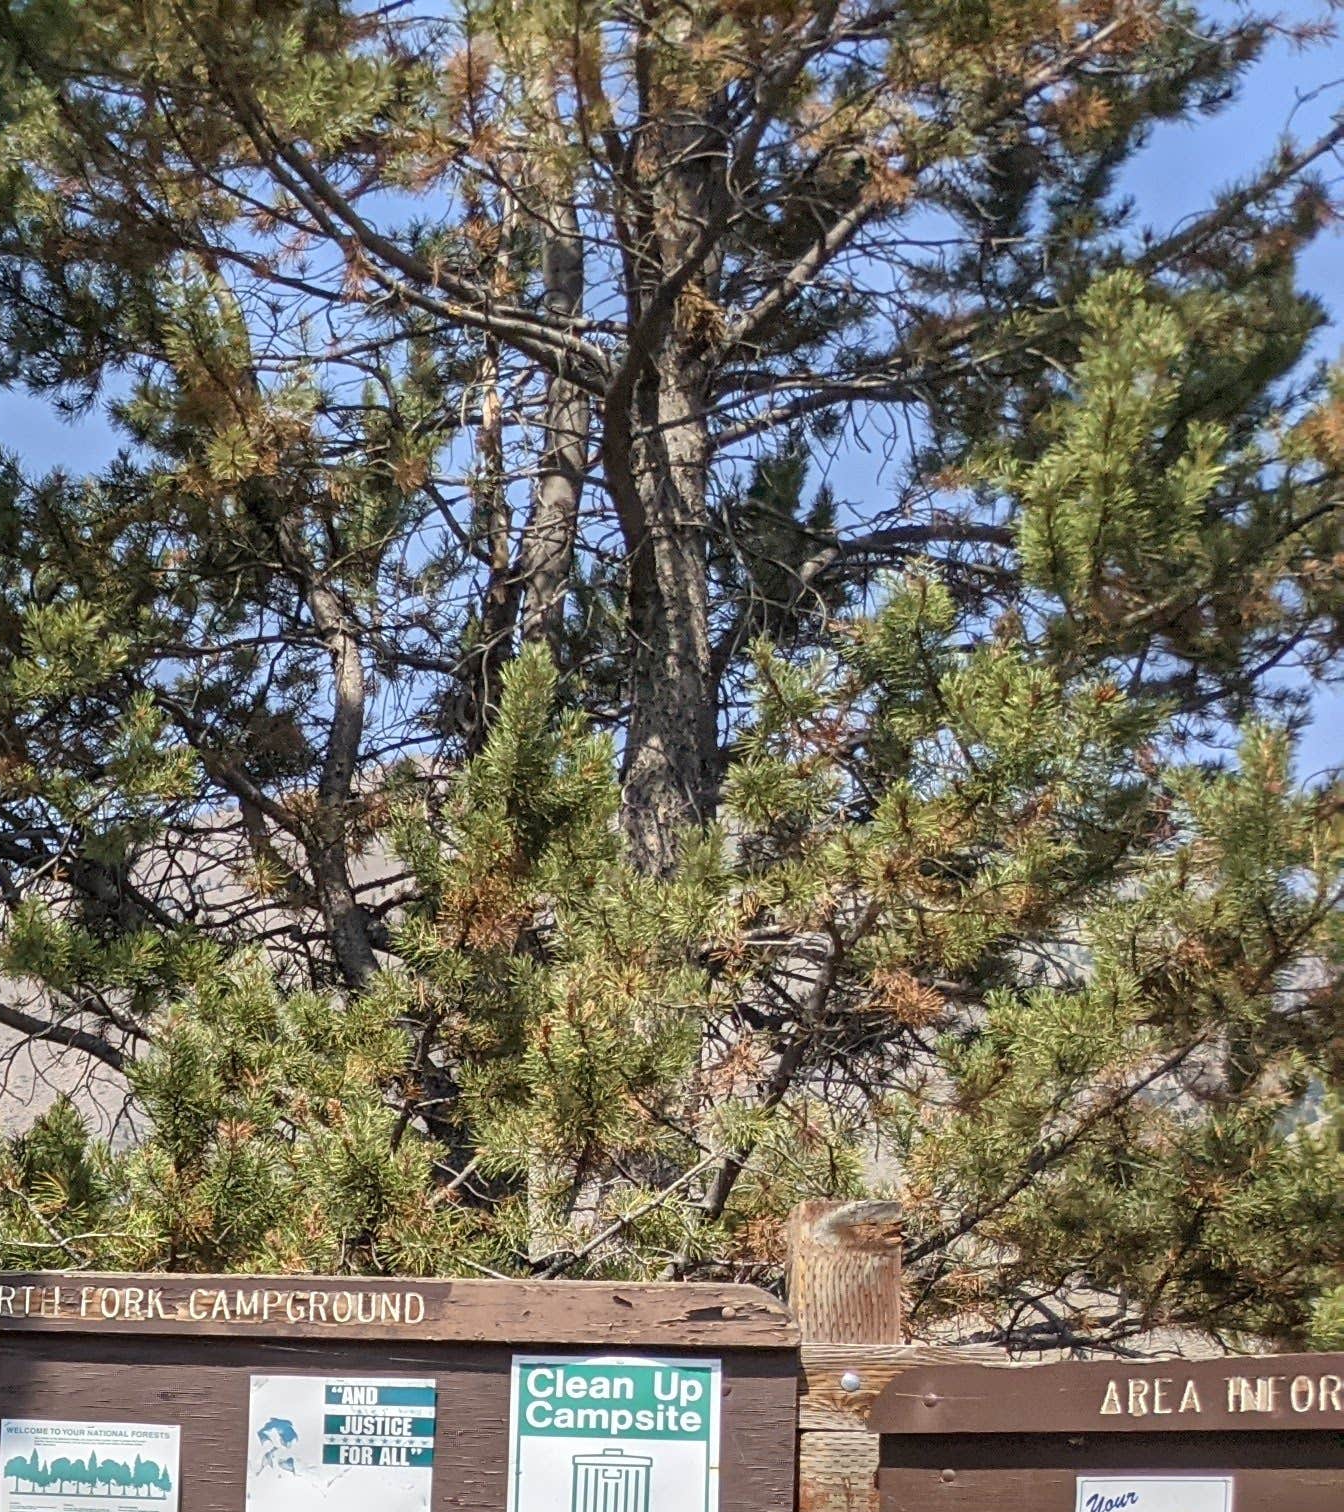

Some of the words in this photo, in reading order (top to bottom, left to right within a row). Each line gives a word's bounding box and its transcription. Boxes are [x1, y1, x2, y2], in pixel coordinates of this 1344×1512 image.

[81, 1286, 167, 1320] FORK
[189, 1289, 424, 1325] CAMPGROUND
[527, 1368, 634, 1399] Clean
[654, 1371, 703, 1406] Up
[1100, 1380, 1200, 1415] AREA
[1224, 1375, 1344, 1412] INFOR
[7, 1427, 48, 1435] WELCOME
[87, 1430, 128, 1438] NATIONAL
[131, 1431, 170, 1439] FORESTS
[340, 1416, 412, 1436] JUSTICE
[526, 1400, 702, 1434] Campsite
[340, 1446, 373, 1465] FOR
